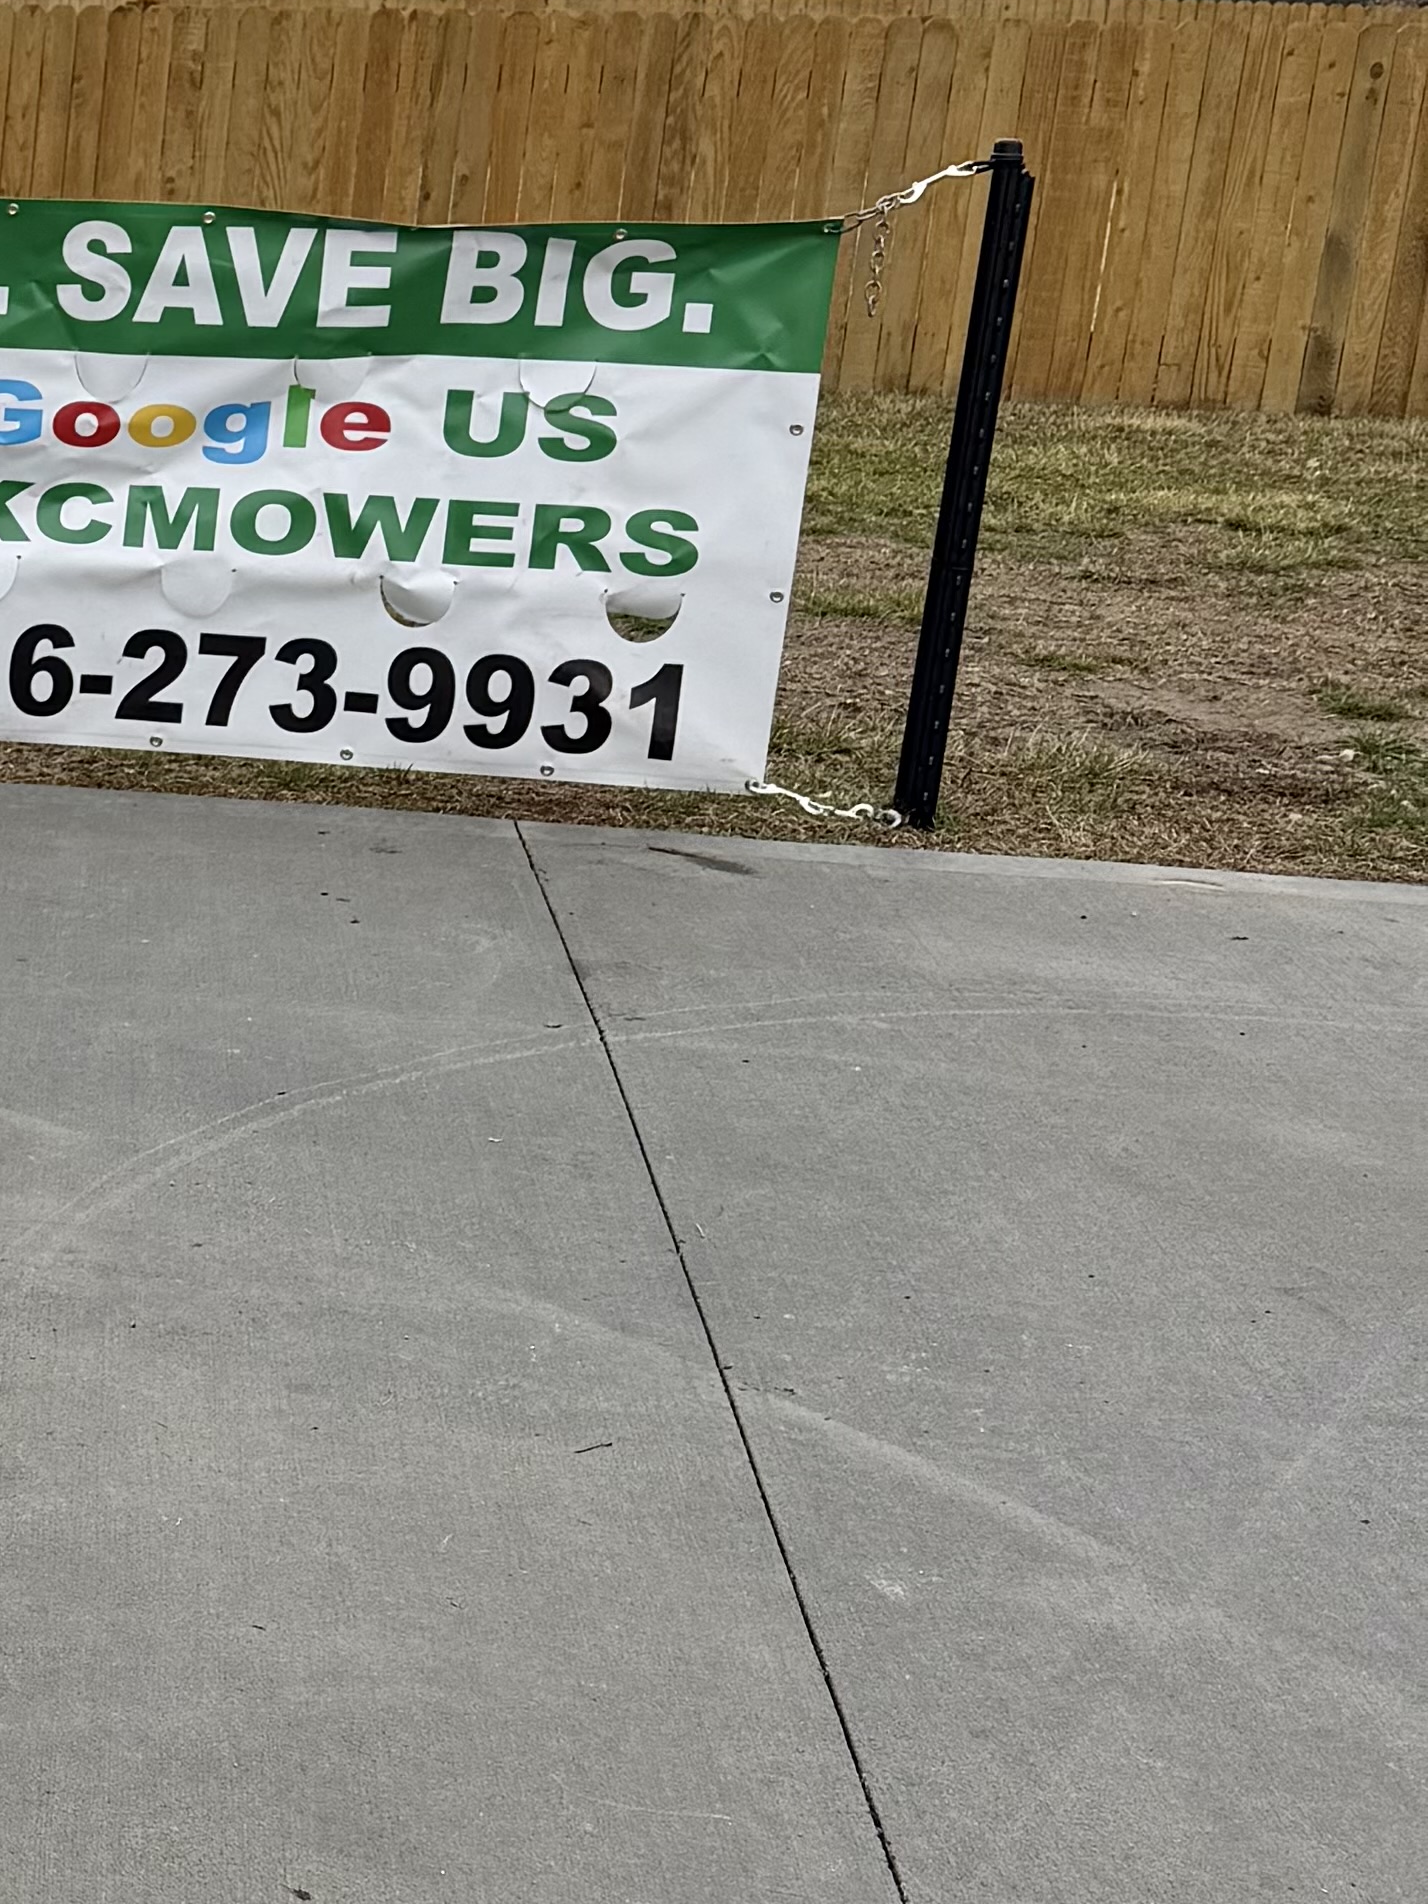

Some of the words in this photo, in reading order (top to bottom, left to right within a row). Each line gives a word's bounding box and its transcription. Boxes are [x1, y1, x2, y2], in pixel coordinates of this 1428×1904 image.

[55, 220, 399, 330] SAVE
[440, 230, 715, 335] BIG.
[442, 387, 619, 463] US
